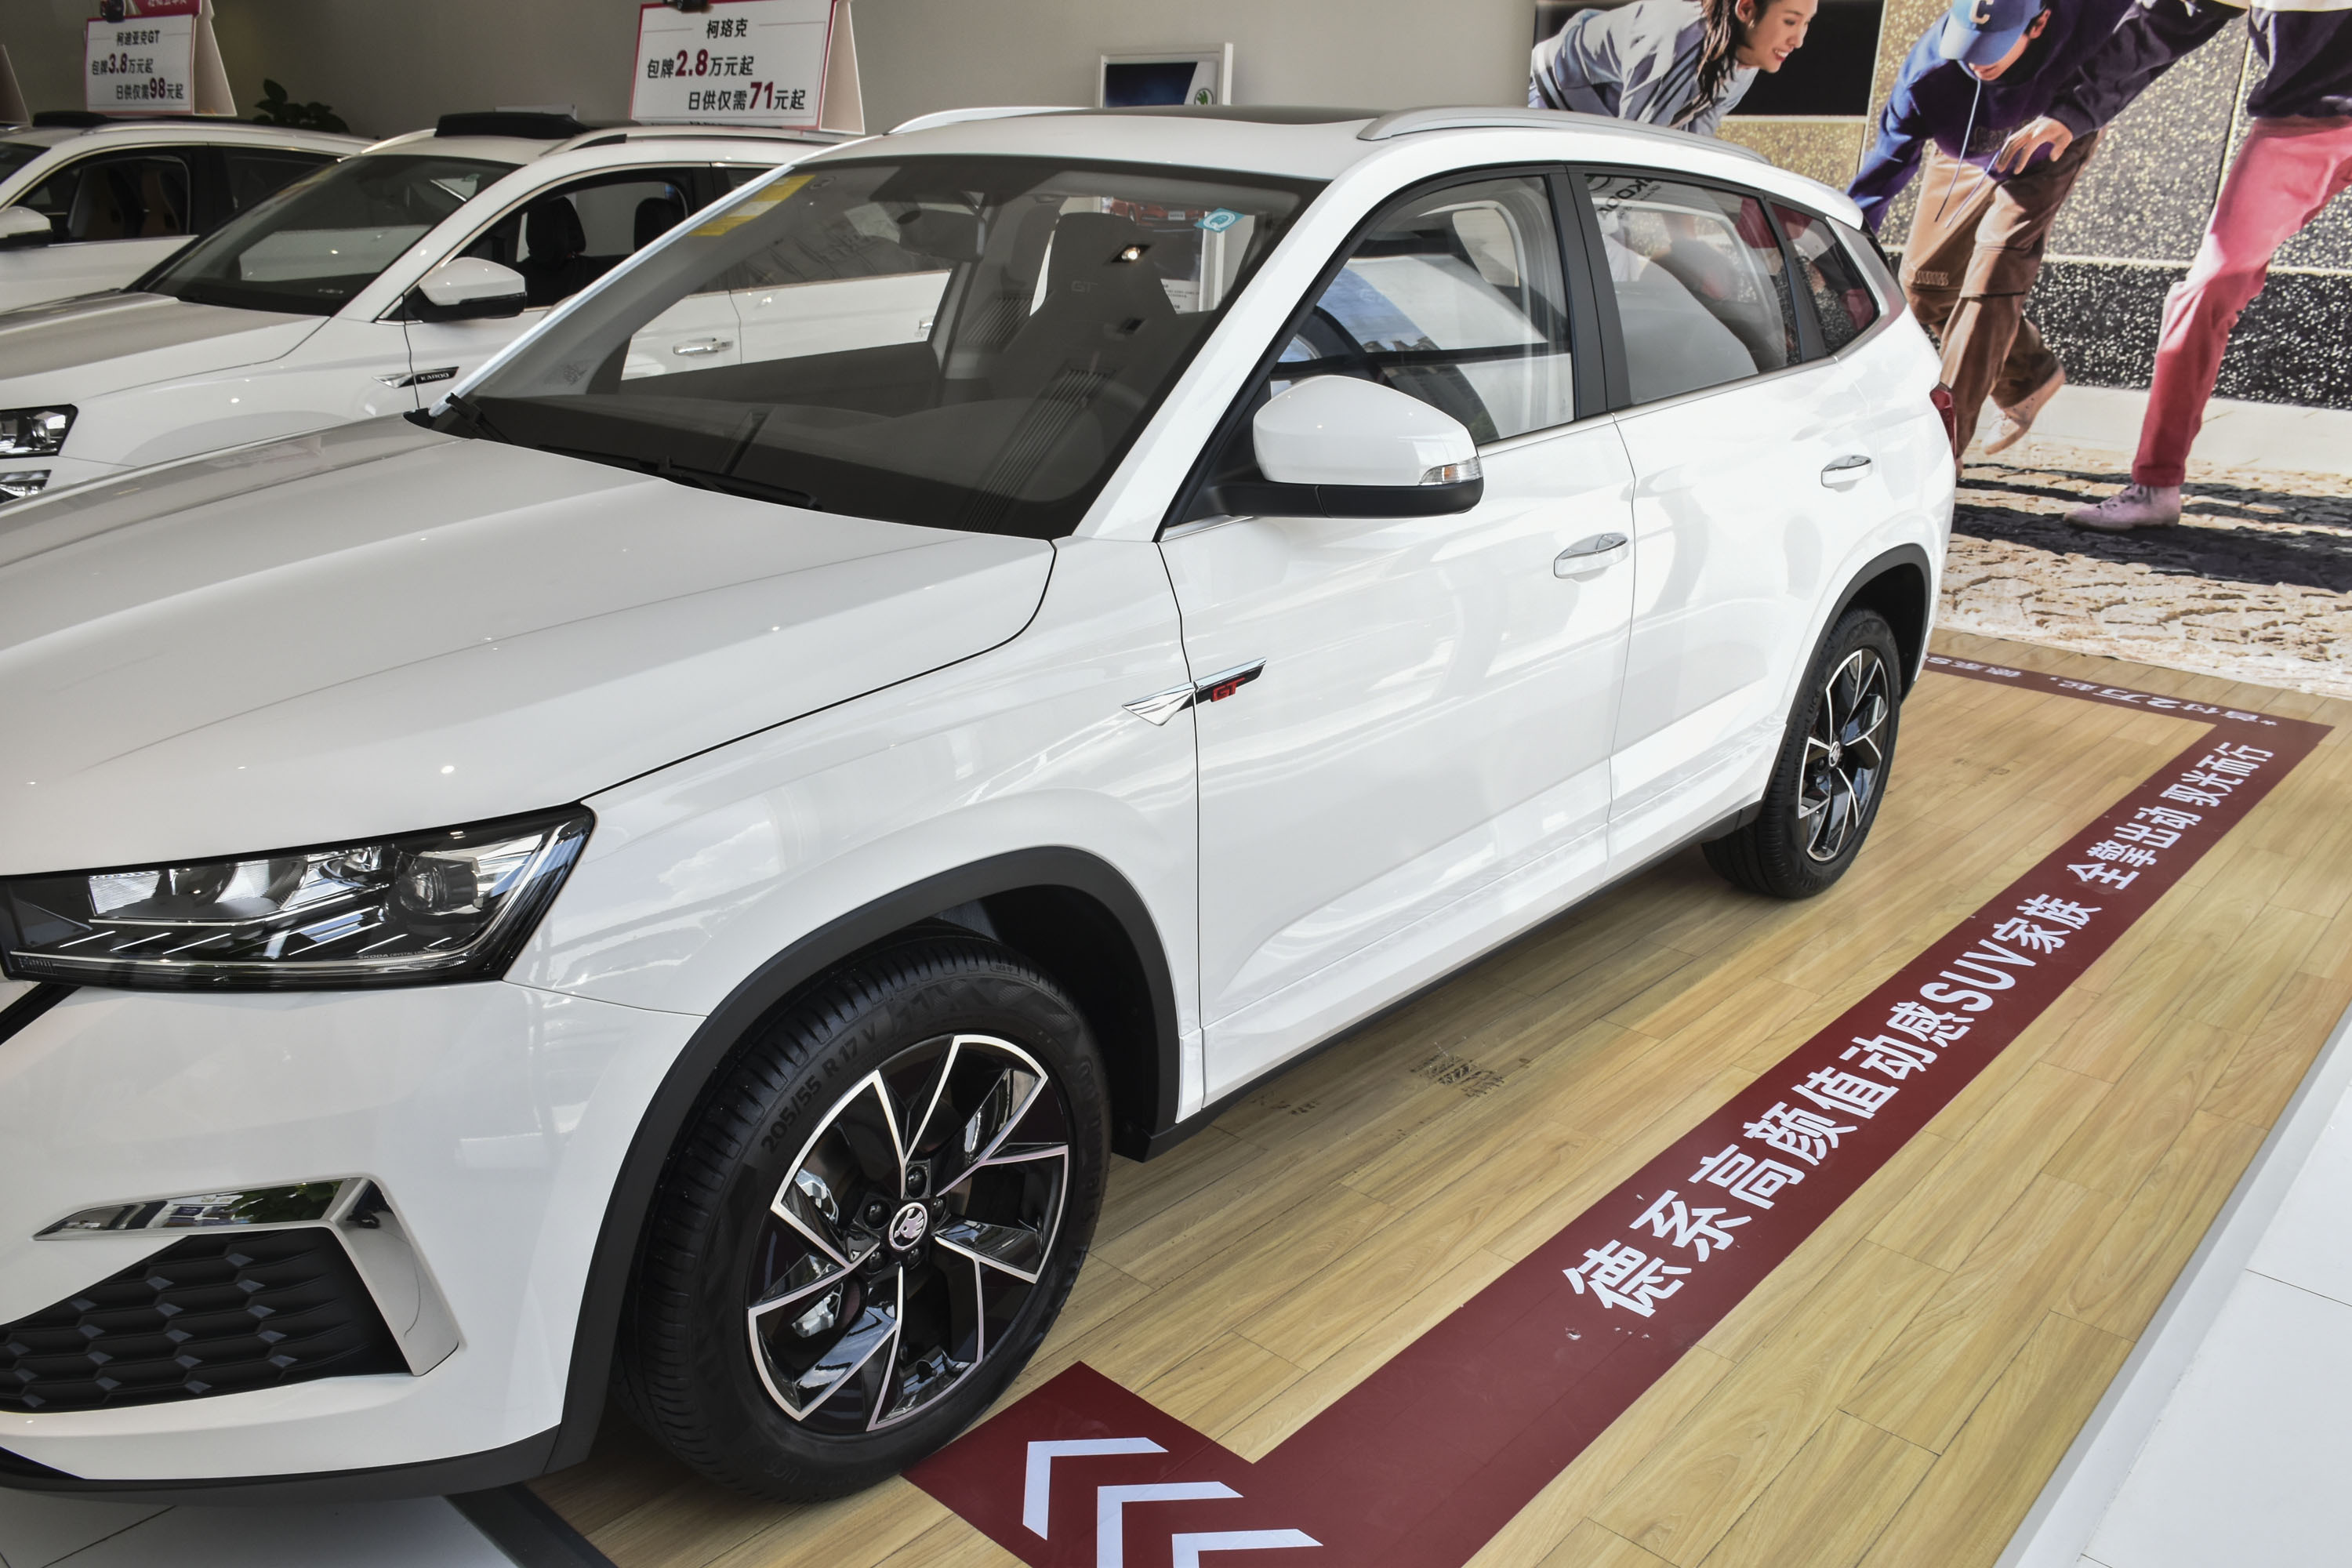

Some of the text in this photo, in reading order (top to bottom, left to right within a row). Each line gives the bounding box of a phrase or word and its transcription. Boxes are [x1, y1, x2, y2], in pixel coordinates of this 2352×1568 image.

[116, 30, 160, 46] 柯迪亚克GT
[706, 18, 749, 39] 柯珞克
[92, 53, 154, 75] 包牌3.8万元起
[647, 49, 755, 79] 包牌2.8万元起
[116, 77, 184, 100] 日供仅需98元起
[688, 81, 806, 111] 日供仅需71元起
[1211, 677, 1245, 702] GT
[1563, 742, 2274, 1318] 德系高颜值动感SUV家族 全擎出动 驭光而行
[760, 1074, 822, 1154] 205/55
